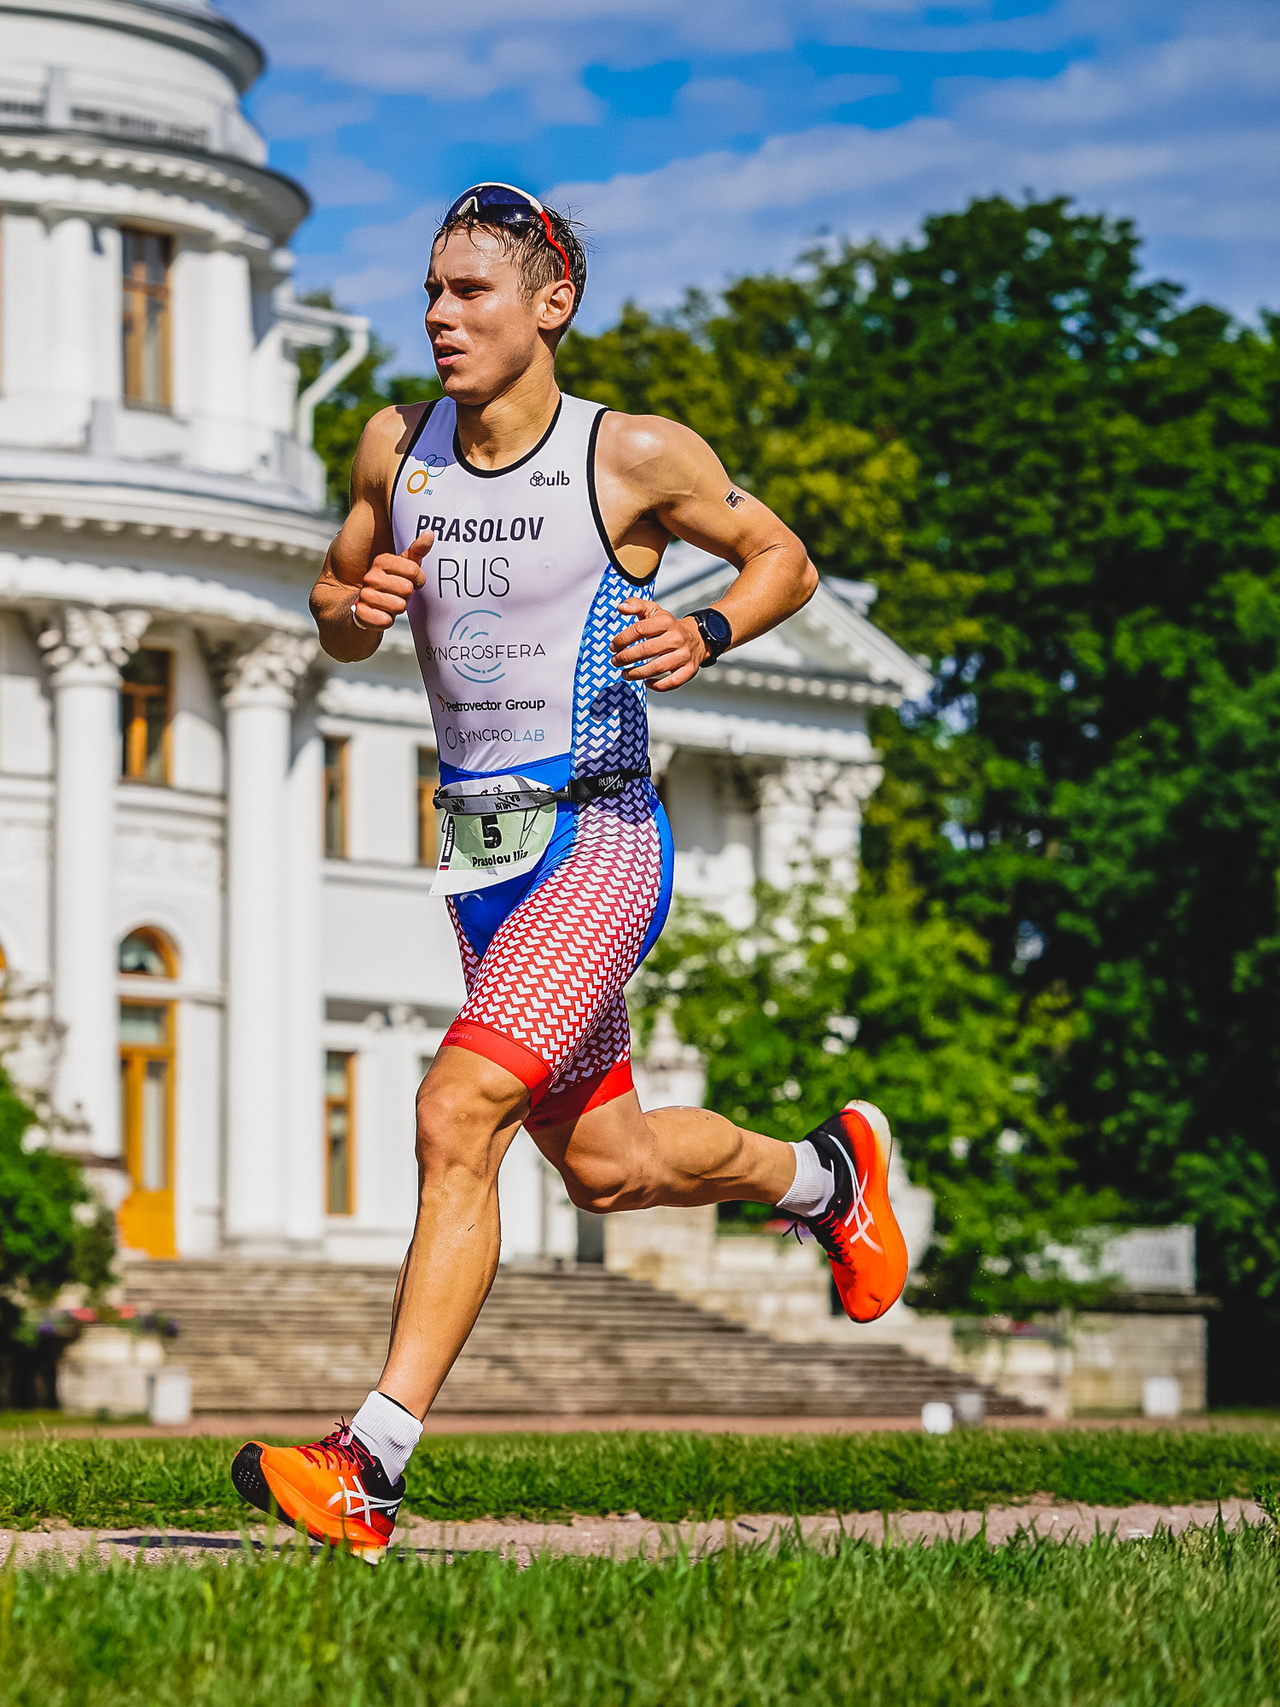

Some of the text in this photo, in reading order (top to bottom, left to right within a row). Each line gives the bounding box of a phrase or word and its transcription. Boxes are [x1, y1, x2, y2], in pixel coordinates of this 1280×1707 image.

[416, 514, 544, 542] PRASOLOV
[438, 557, 510, 598] RUS
[426, 643, 546, 661] SYNCROSFERA
[446, 699, 545, 712] Petrovector Group
[458, 729, 545, 743] SYNCROLAB
[481, 814, 502, 848] 5
